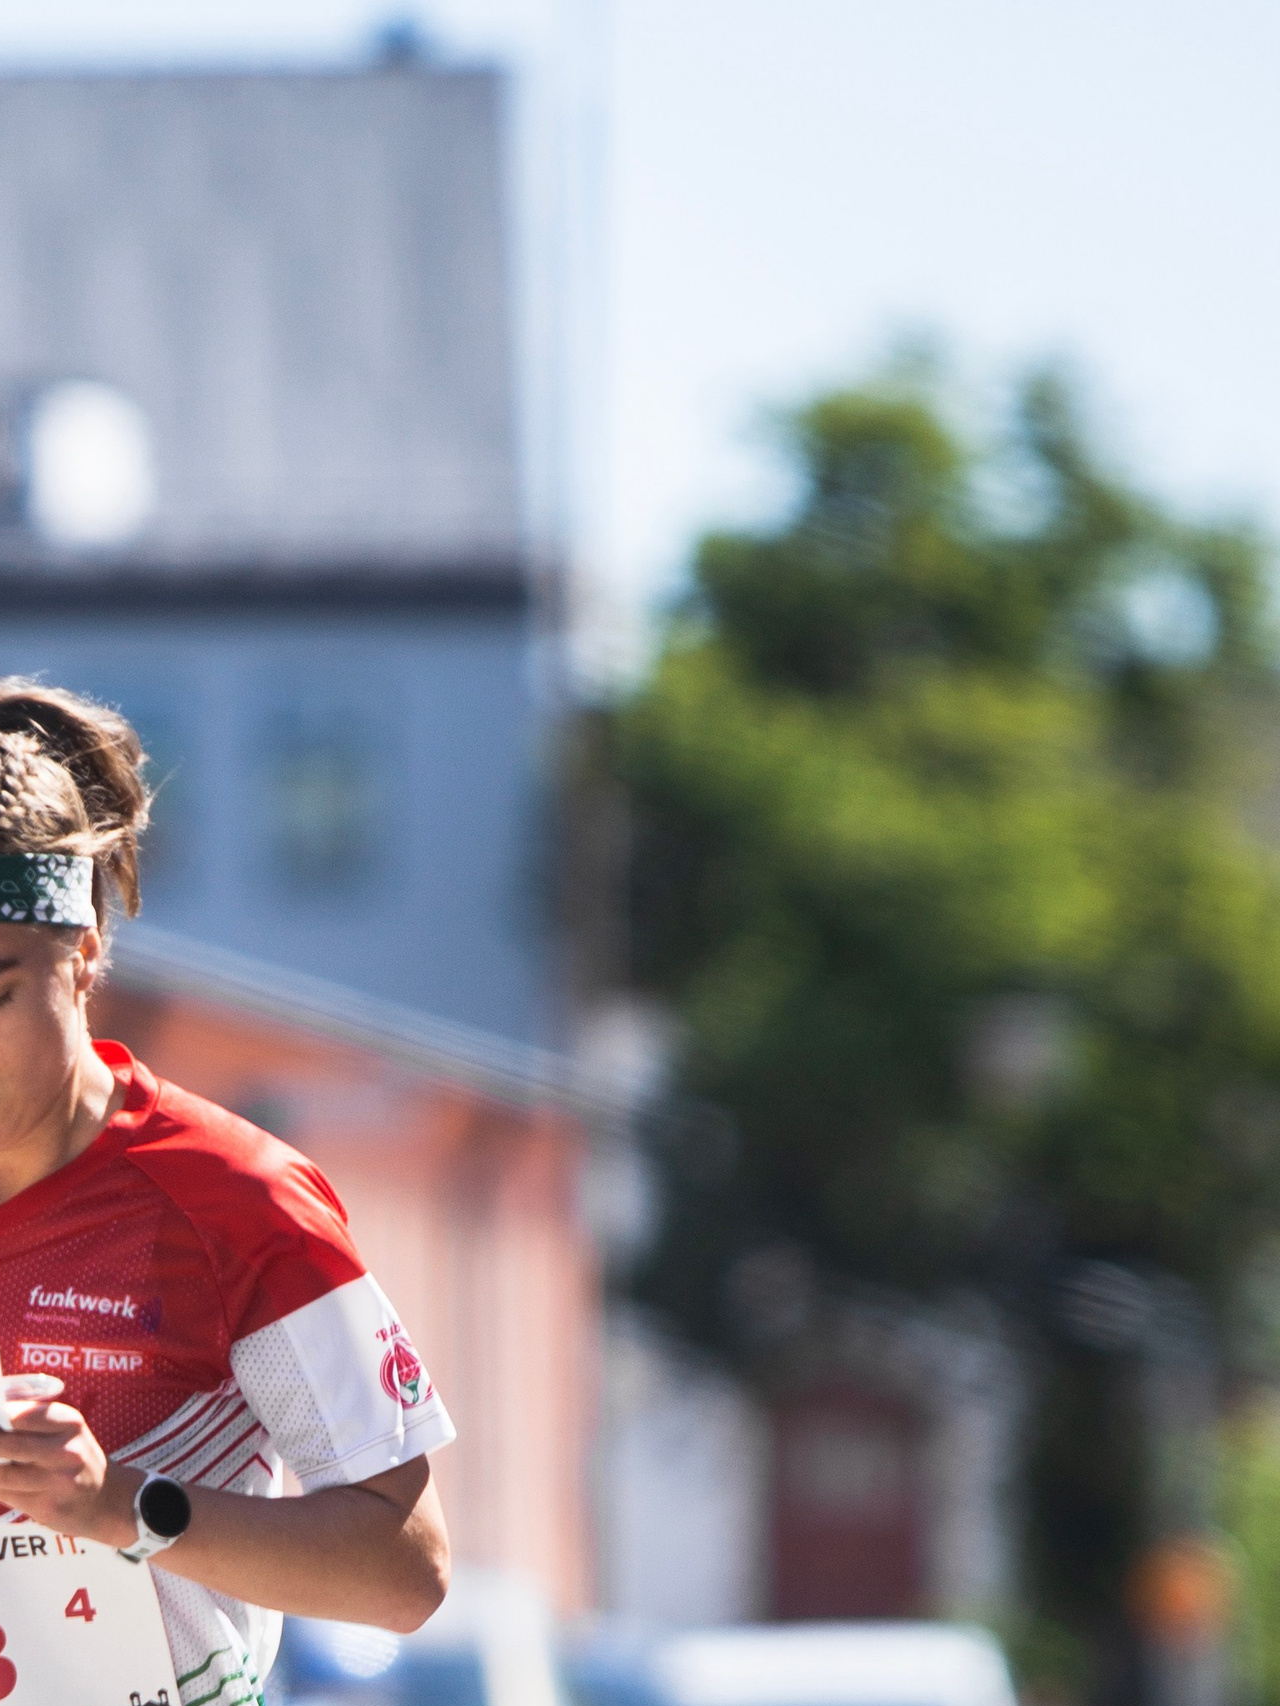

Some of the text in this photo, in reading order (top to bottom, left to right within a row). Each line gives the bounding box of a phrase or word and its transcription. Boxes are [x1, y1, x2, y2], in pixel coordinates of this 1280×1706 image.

[29, 1284, 138, 1319] funkwerk
[20, 1342, 144, 1371] TOOL-TEMP
[64, 1587, 97, 1622] 4
